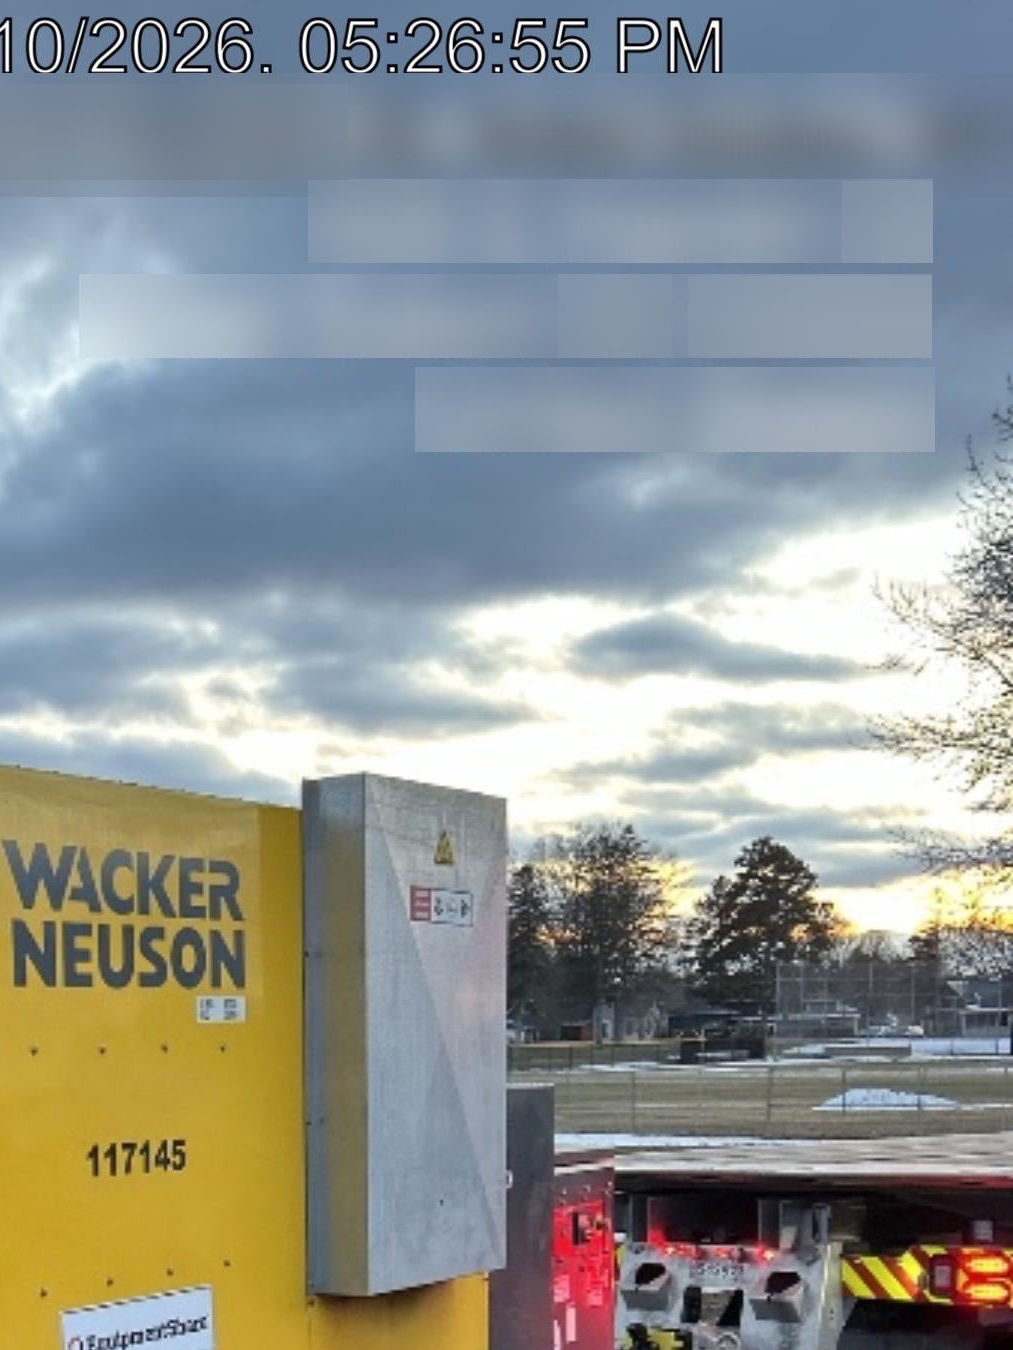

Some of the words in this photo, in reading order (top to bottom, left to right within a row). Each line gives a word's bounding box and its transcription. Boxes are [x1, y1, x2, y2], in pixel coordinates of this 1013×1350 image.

[2, 840, 245, 920] WACKER
[12, 921, 246, 989] NEUSON
[87, 1139, 186, 1176] 117145
